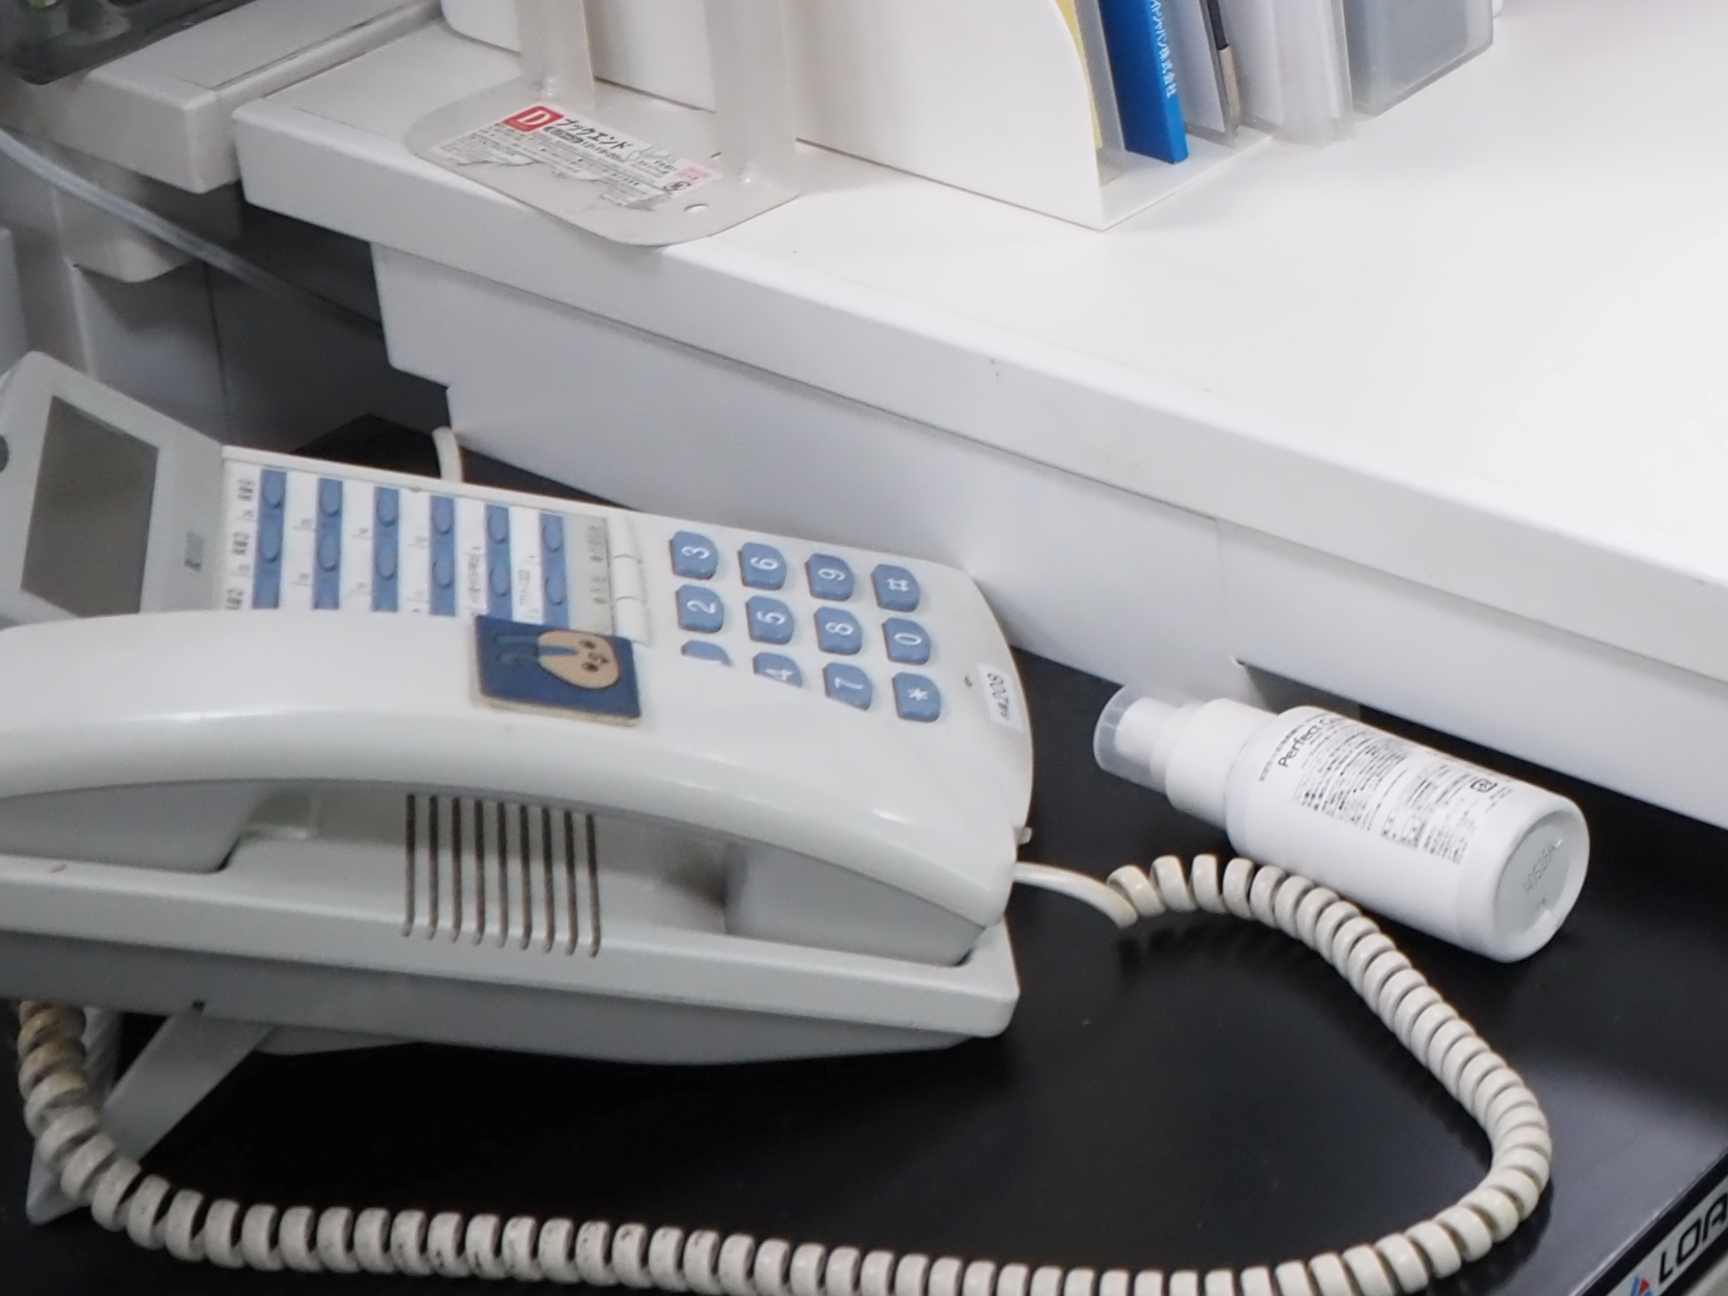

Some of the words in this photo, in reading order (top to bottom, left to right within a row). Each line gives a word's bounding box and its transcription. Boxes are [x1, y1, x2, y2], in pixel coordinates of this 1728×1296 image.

[682, 545, 710, 560] 3
[751, 556, 778, 571] 6
[818, 567, 846, 582] 9
[687, 599, 716, 615] 2
[756, 611, 787, 626] 5
[825, 621, 854, 637] 8
[893, 632, 923, 648] 0
